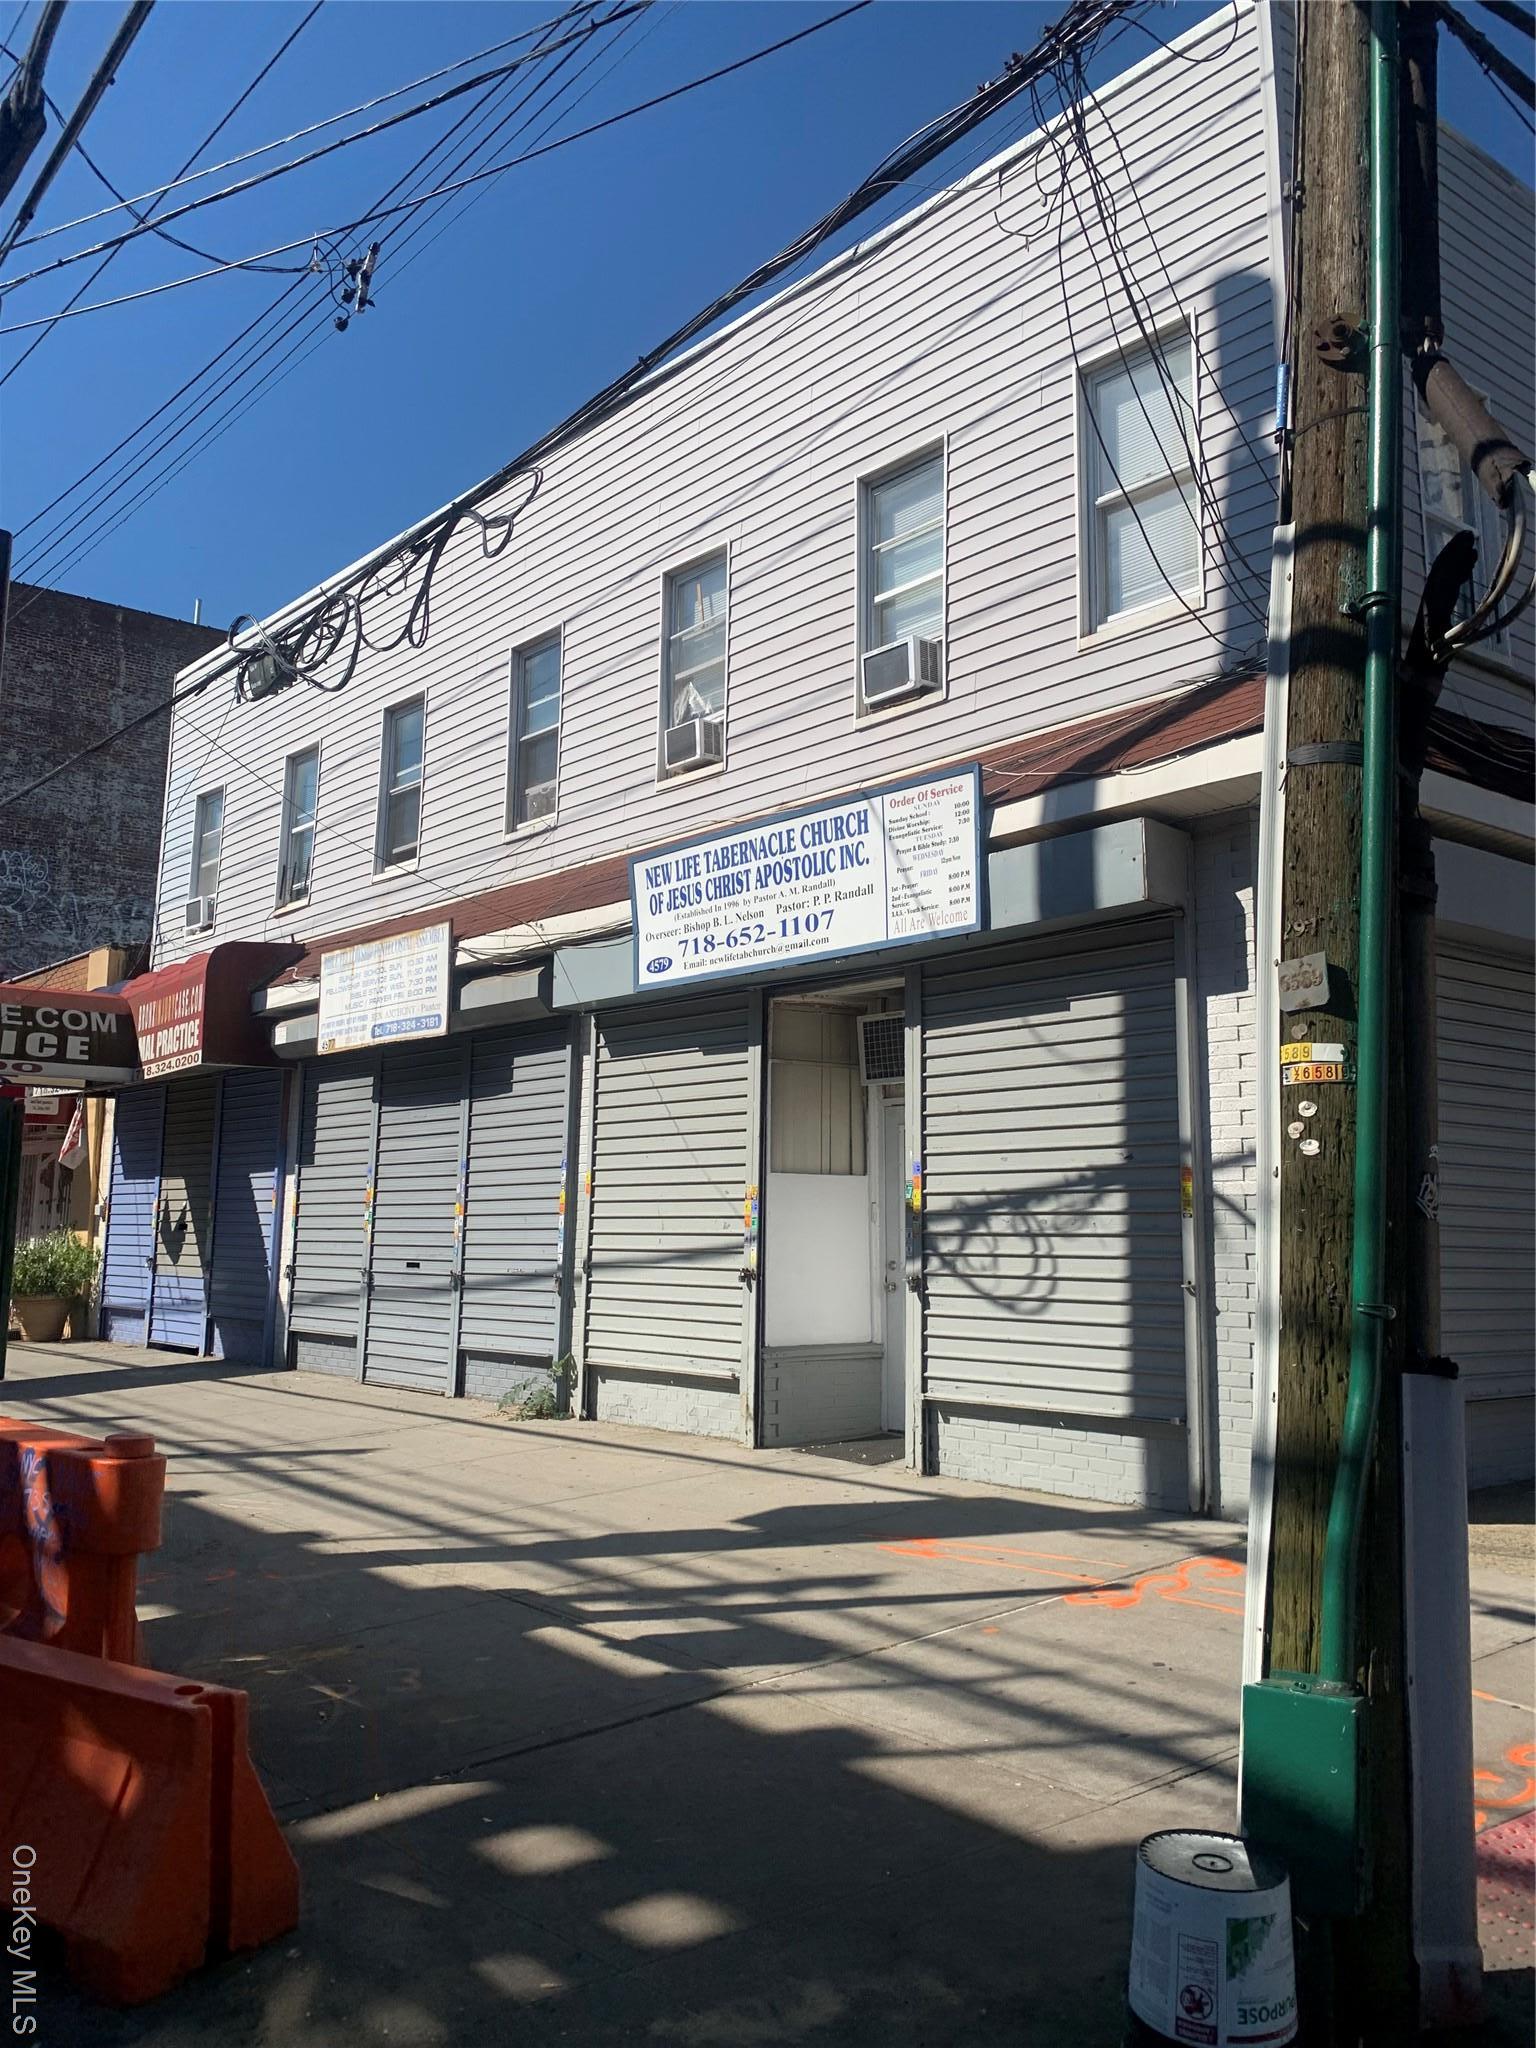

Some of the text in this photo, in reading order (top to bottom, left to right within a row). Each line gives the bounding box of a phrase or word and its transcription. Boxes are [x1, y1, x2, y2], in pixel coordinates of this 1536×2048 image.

[889, 784, 964, 809] Order Of Service
[914, 800, 941, 810] SUNDAY
[954, 801, 970, 809] 10:00
[888, 816, 908, 825] Sunday
[954, 809, 970, 817] 12:00
[888, 824, 905, 833] Divine
[888, 824, 944, 841] Evangelistic Service:
[916, 832, 943, 842] TUESDAY
[645, 808, 869, 890] NEW LIFE TABERNACLE CHURCH
[896, 848, 912, 856] Prayer
[917, 842, 930, 851] Bible
[912, 849, 944, 861] WEDNESDAY
[649, 840, 870, 916] OF JESUS CHRIST APOSTOLIC INC.
[919, 868, 938, 878] FRIDAY
[674, 905, 713, 922] (Established
[714, 904, 722, 912] In
[743, 898, 751, 907] by
[753, 893, 776, 904] Pastor
[778, 890, 787, 898] A.
[789, 887, 800, 896] M.
[801, 879, 836, 893] Randall)
[776, 884, 874, 914] Pastor: P. P. Randall
[904, 889, 932, 900] Evangelistic
[645, 910, 764, 942] Overseer: Bishop B. L. Nelson
[893, 910, 968, 935] All Are Welcome
[678, 909, 834, 958] 718-652-1107
[683, 936, 829, 970] Email: newlifetabchurch@gmail.com
[425, 964, 438, 973] AM
[649, 958, 669, 973] 4579
[425, 975, 438, 984] PM
[425, 985, 438, 994] PM
[1, 1003, 117, 1033] E.COM
[156, 1018, 200, 1057] PRACTICE
[2, 1031, 90, 1061] ICE
